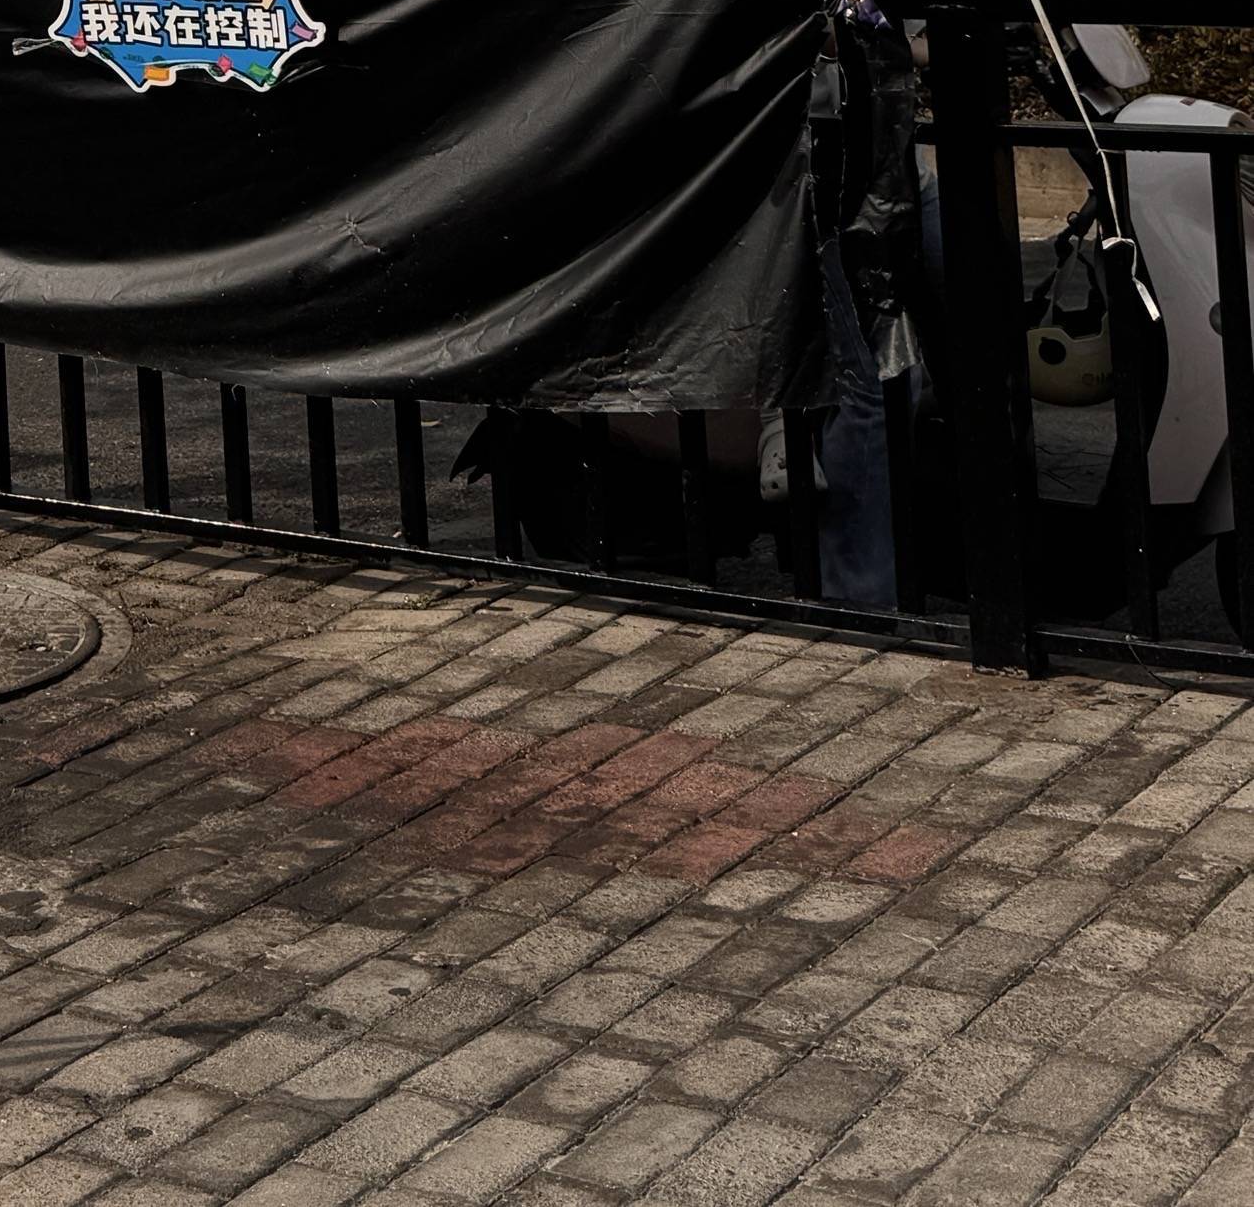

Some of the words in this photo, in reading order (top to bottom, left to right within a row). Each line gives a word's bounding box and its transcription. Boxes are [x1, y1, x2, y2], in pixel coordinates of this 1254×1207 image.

[81, 1, 289, 50] 我还在控制
